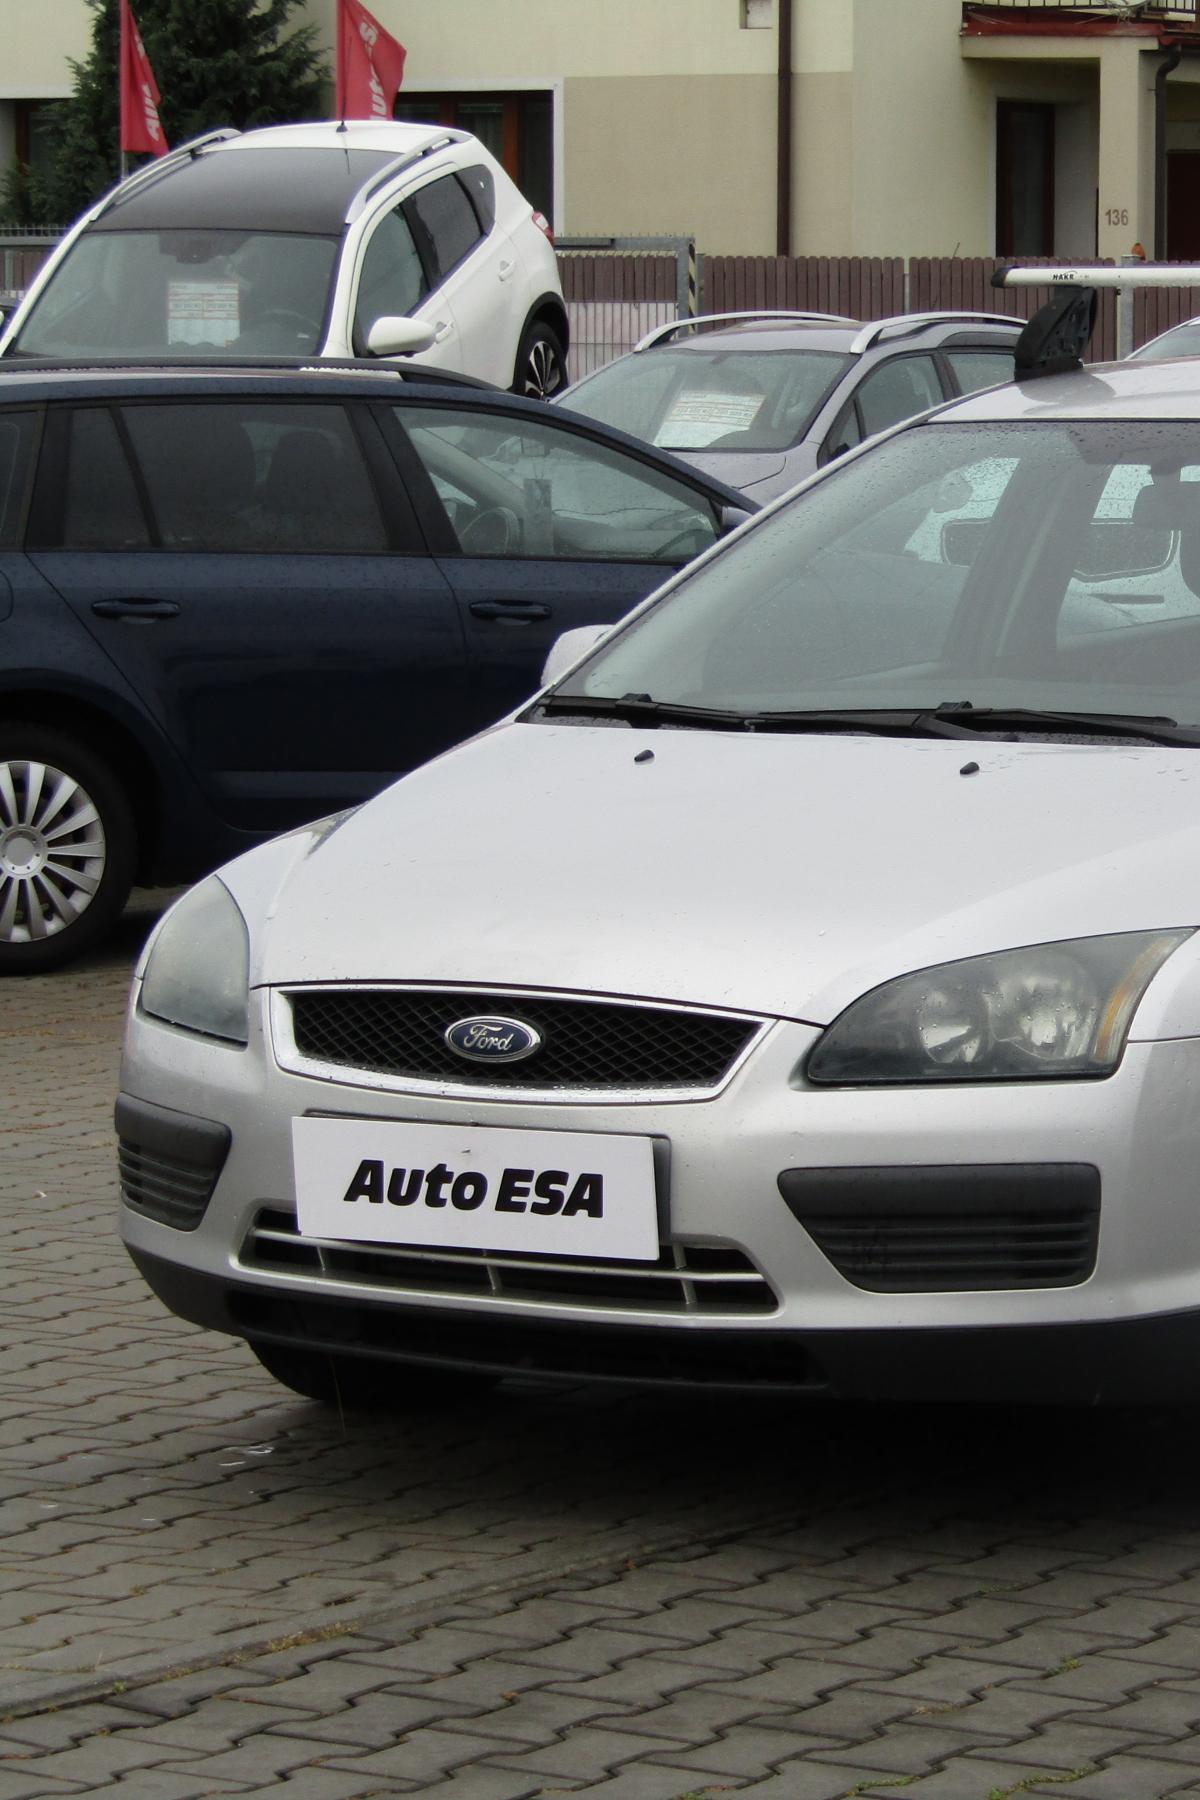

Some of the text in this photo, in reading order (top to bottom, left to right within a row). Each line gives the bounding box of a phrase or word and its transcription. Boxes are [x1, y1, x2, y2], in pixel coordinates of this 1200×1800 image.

[1104, 208, 1129, 227] 136
[463, 1024, 514, 1051] Ford
[343, 1159, 604, 1219] Auto ESA
